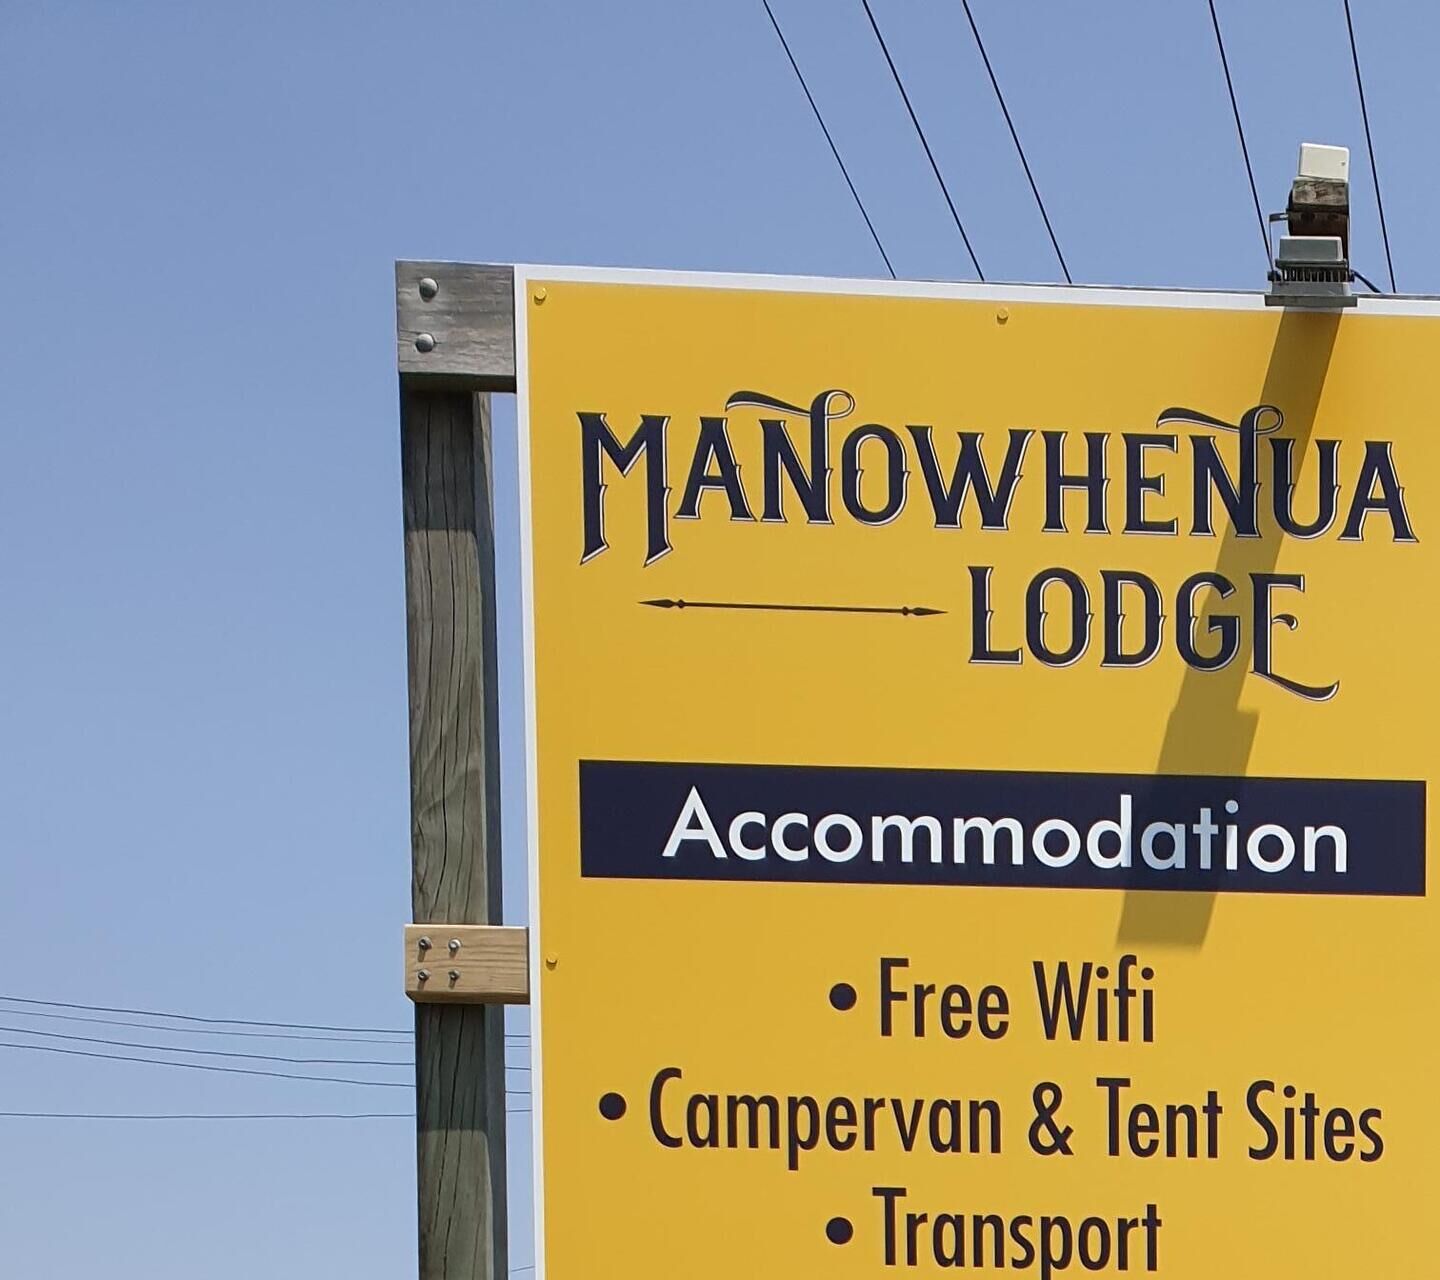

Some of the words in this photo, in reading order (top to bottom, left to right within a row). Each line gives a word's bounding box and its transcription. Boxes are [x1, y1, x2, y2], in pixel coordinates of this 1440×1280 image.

[577, 389, 1419, 567] MANOWHENUA
[967, 565, 1340, 702] LODGE
[662, 785, 1348, 874] Accommodation
[879, 956, 1011, 1041] Free
[1033, 954, 1156, 1043] Wifi
[648, 1067, 1002, 1171] Campervan
[1028, 1081, 1074, 1156] &
[1096, 1077, 1223, 1159] Tent
[1247, 1079, 1385, 1163] Sites
